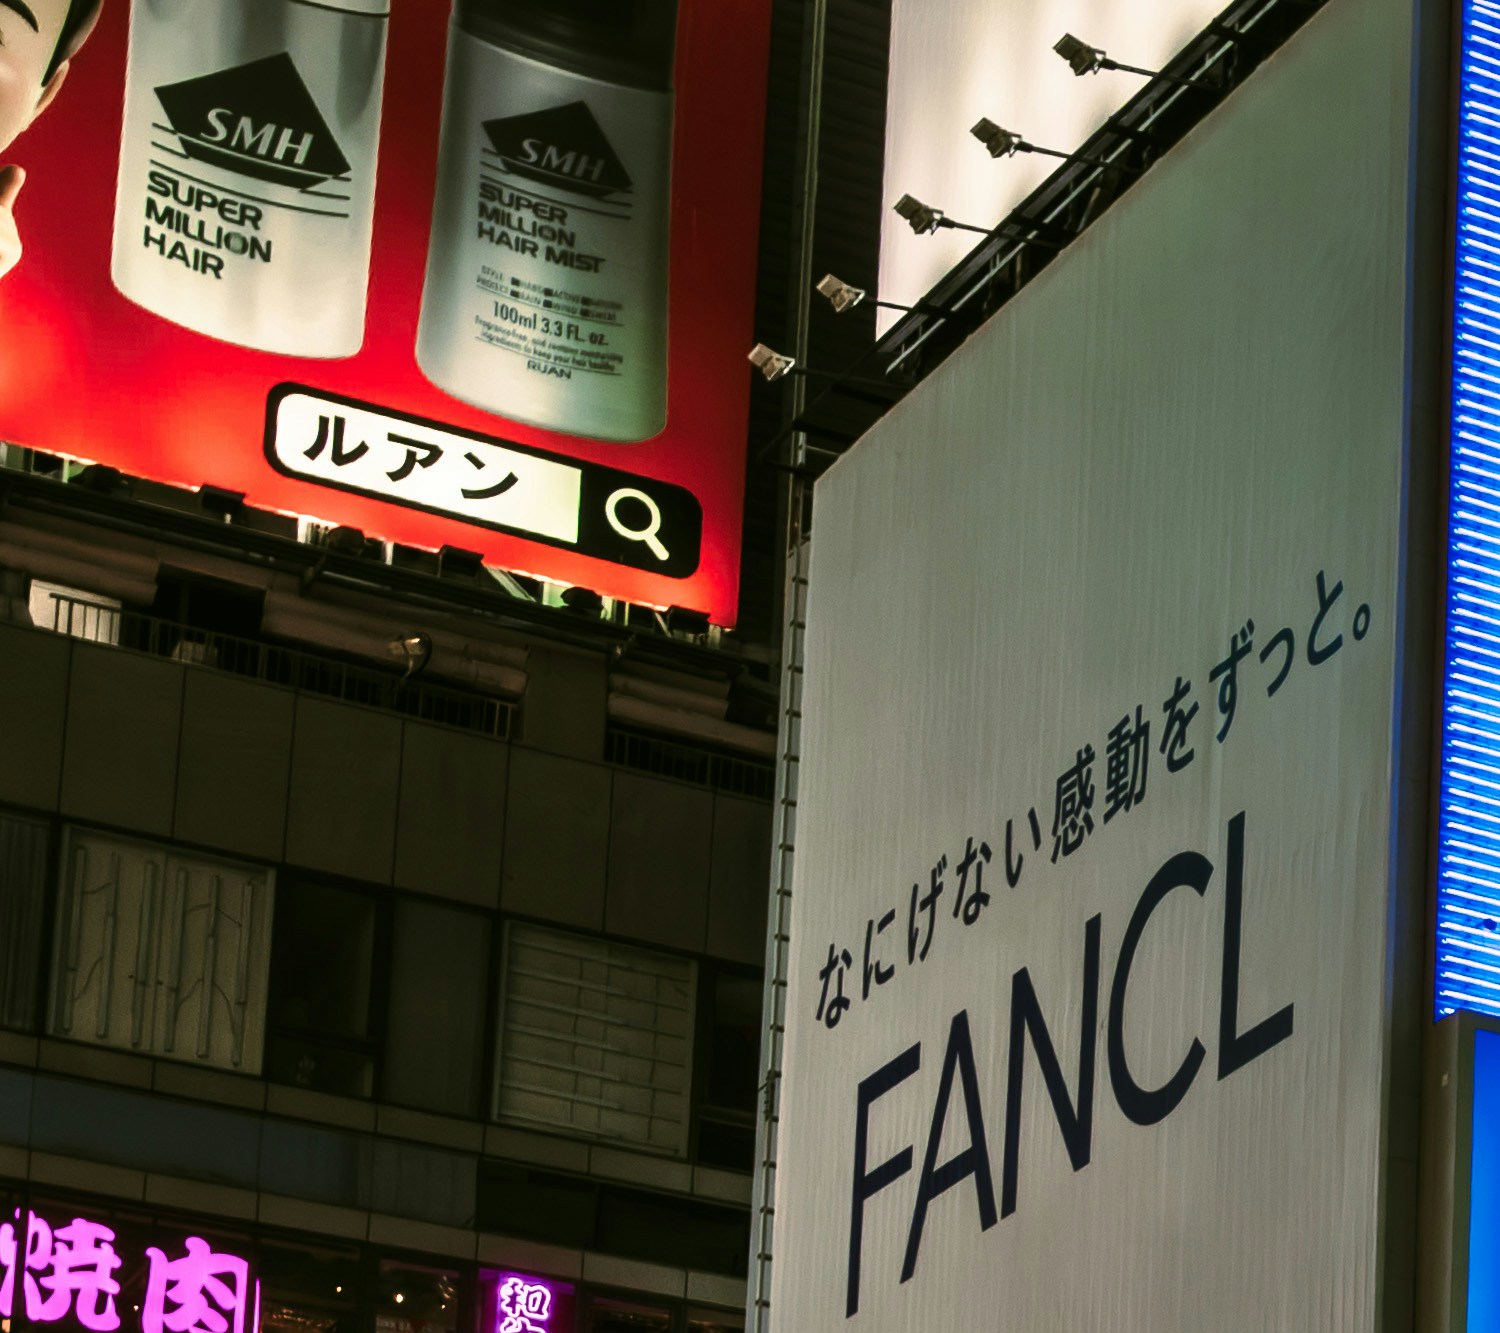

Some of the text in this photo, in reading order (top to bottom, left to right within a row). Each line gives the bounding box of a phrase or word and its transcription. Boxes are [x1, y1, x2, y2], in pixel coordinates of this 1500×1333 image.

[202, 107, 314, 166] SMH
[518, 137, 606, 179] SMH
[147, 171, 262, 232] SUPER
[477, 202, 576, 248] MILLION
[479, 181, 568, 224] SUPER
[143, 226, 224, 280] HAIR
[145, 198, 272, 264] MILLION
[477, 221, 606, 274] HAIR MIST
[494, 301, 537, 330] 100ml
[527, 359, 572, 379] RUAN
[304, 414, 519, 501] ルアン
[815, 568, 1372, 1030] なにげない感動をずっと。
[845, 808, 1296, 1319] FANCL
